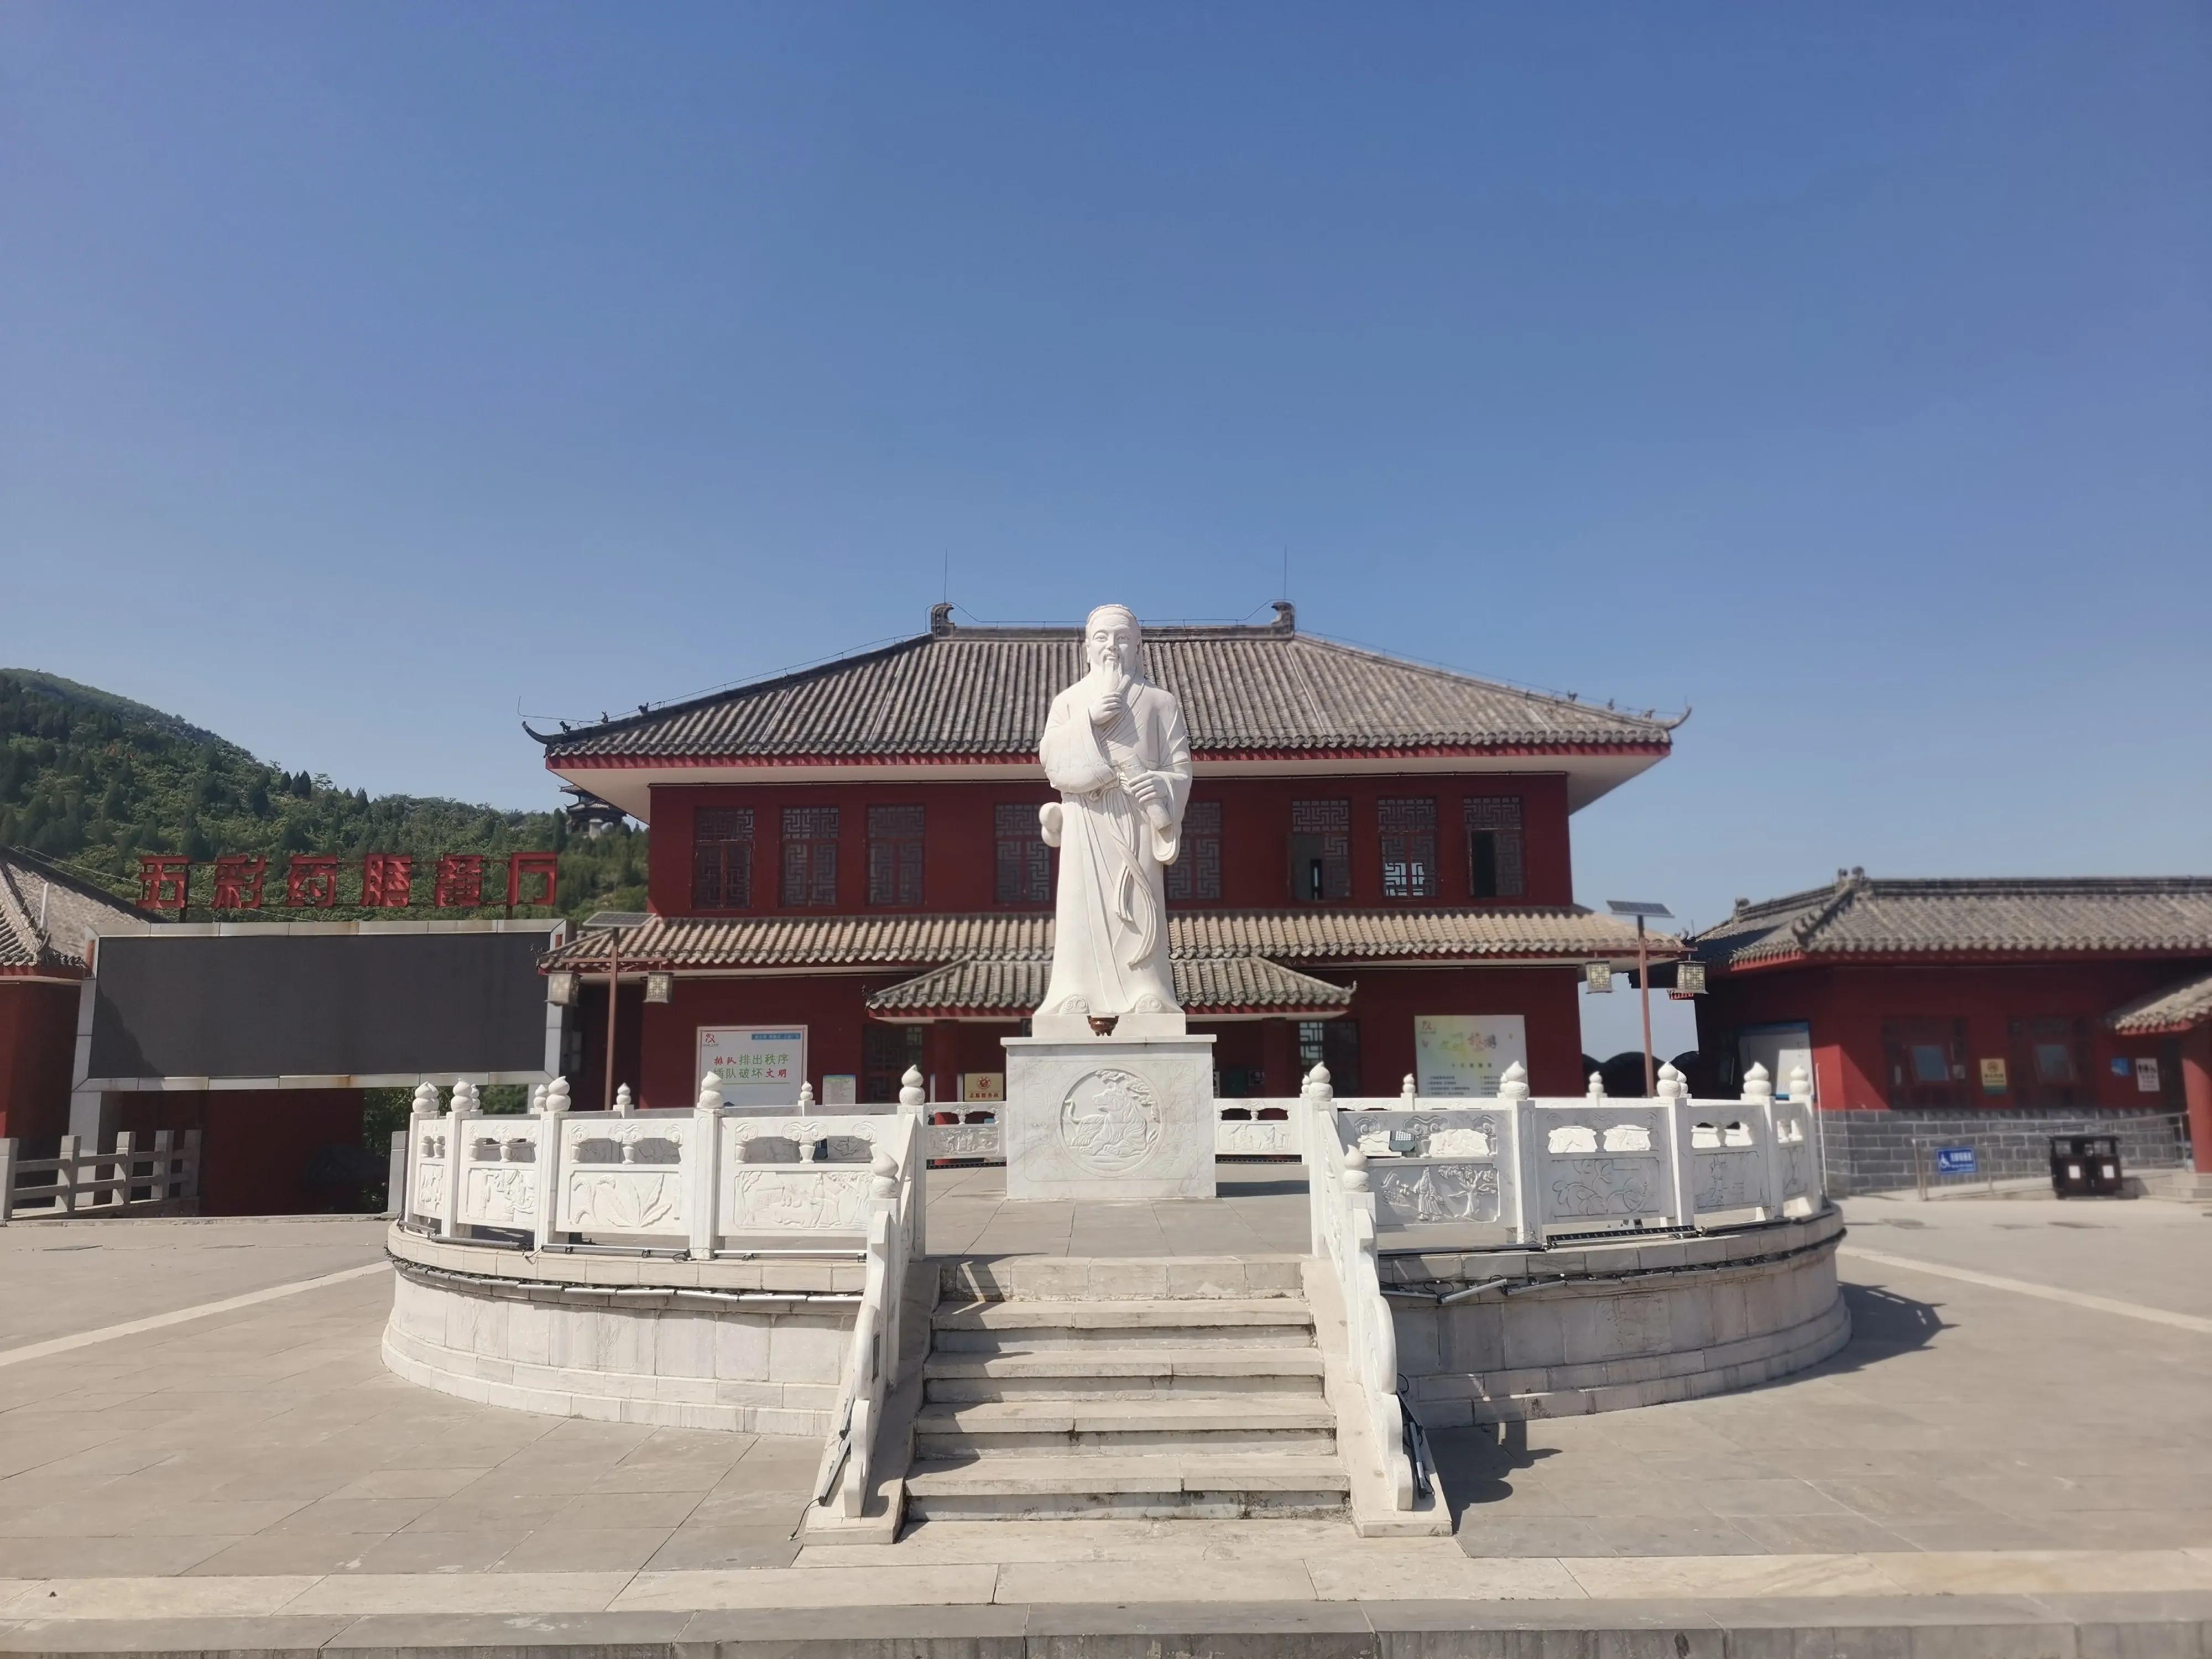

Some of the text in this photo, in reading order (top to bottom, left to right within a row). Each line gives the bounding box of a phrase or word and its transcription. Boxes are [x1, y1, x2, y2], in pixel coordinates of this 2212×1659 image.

[136, 852, 557, 909] 五彩药膳餐厅
[714, 1053, 789, 1066] 排队排出秩序
